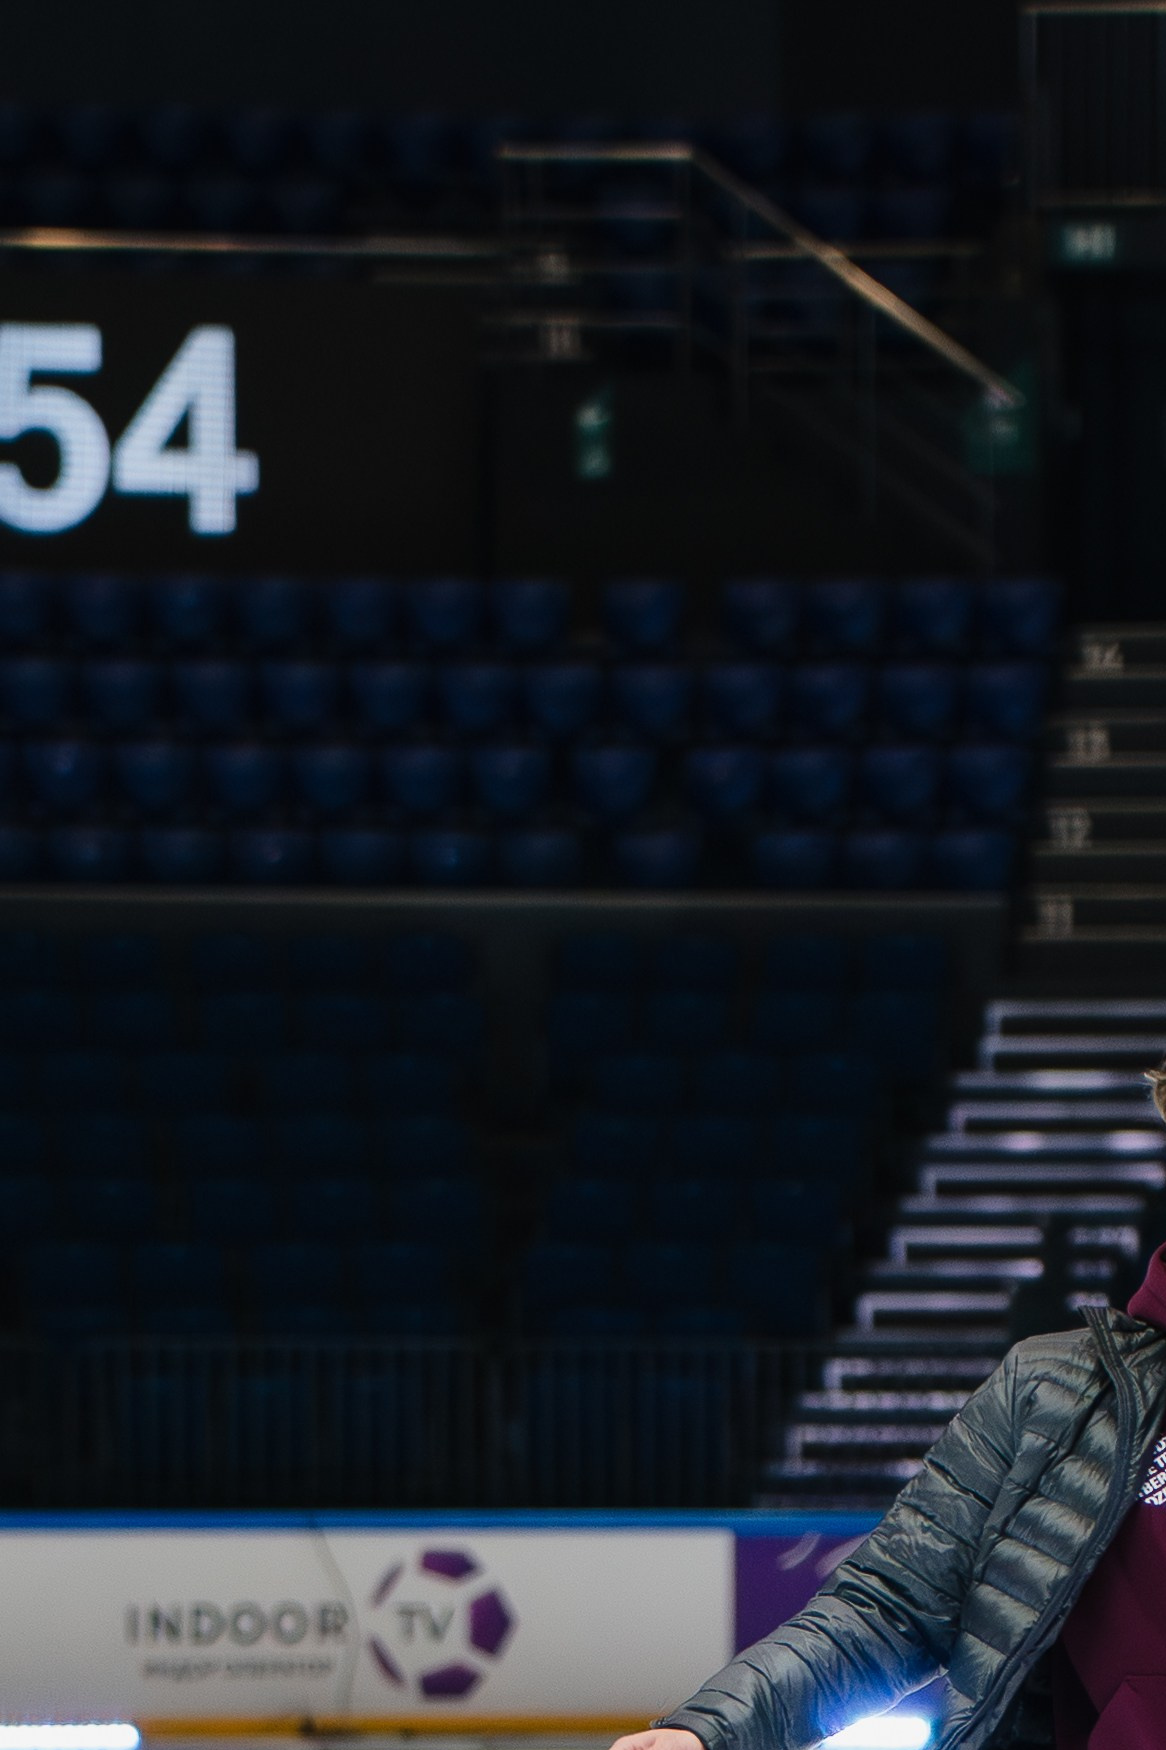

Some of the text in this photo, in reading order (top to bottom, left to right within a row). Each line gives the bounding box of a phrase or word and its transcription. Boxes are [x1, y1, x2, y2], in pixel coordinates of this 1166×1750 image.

[0, 322, 259, 535] 54
[124, 1599, 456, 1648] INDOOR TV
